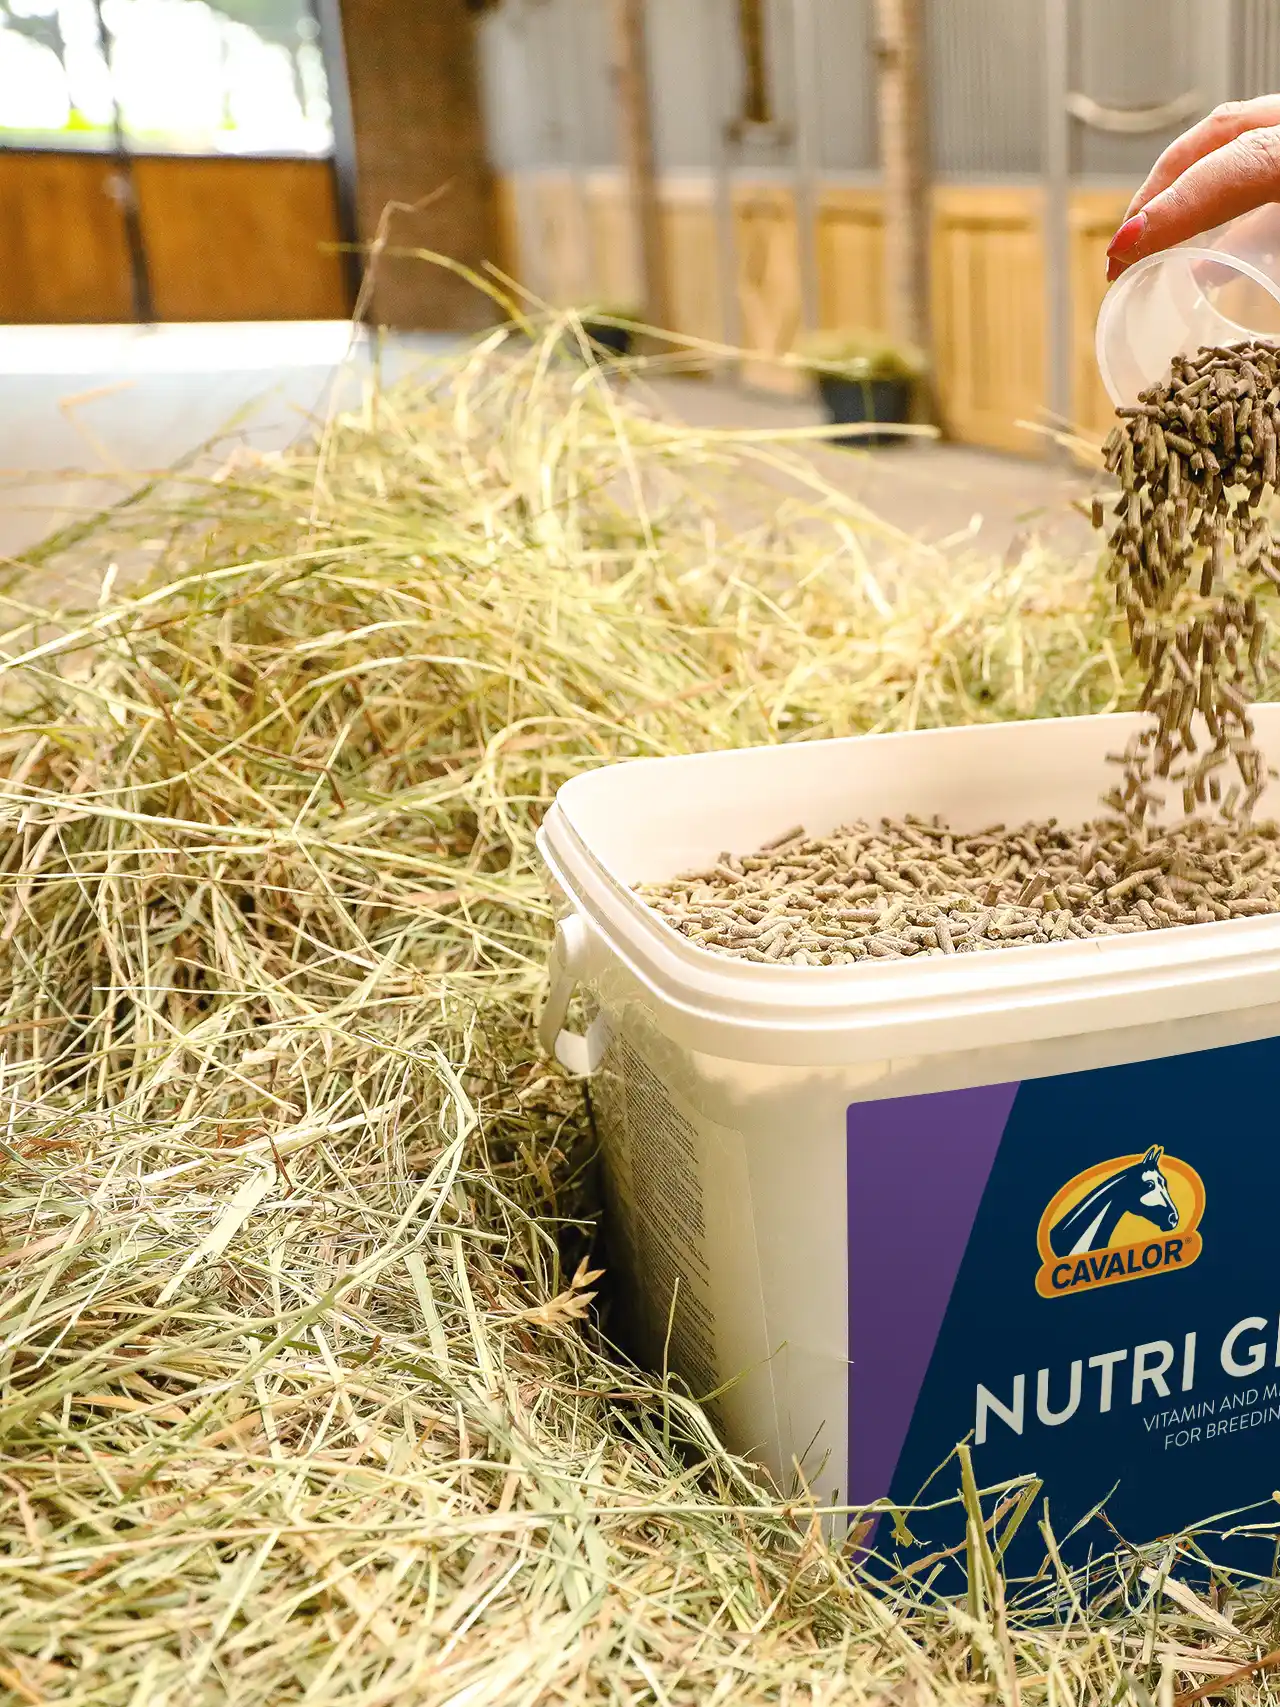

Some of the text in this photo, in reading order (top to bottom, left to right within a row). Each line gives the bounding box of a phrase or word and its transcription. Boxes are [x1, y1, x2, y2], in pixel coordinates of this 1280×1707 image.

[974, 1331, 1197, 1446] NUTRI
[1143, 1400, 1215, 1432] VITAMIN
[1219, 1388, 1259, 1413] AND
[1164, 1427, 1202, 1450] FOR
